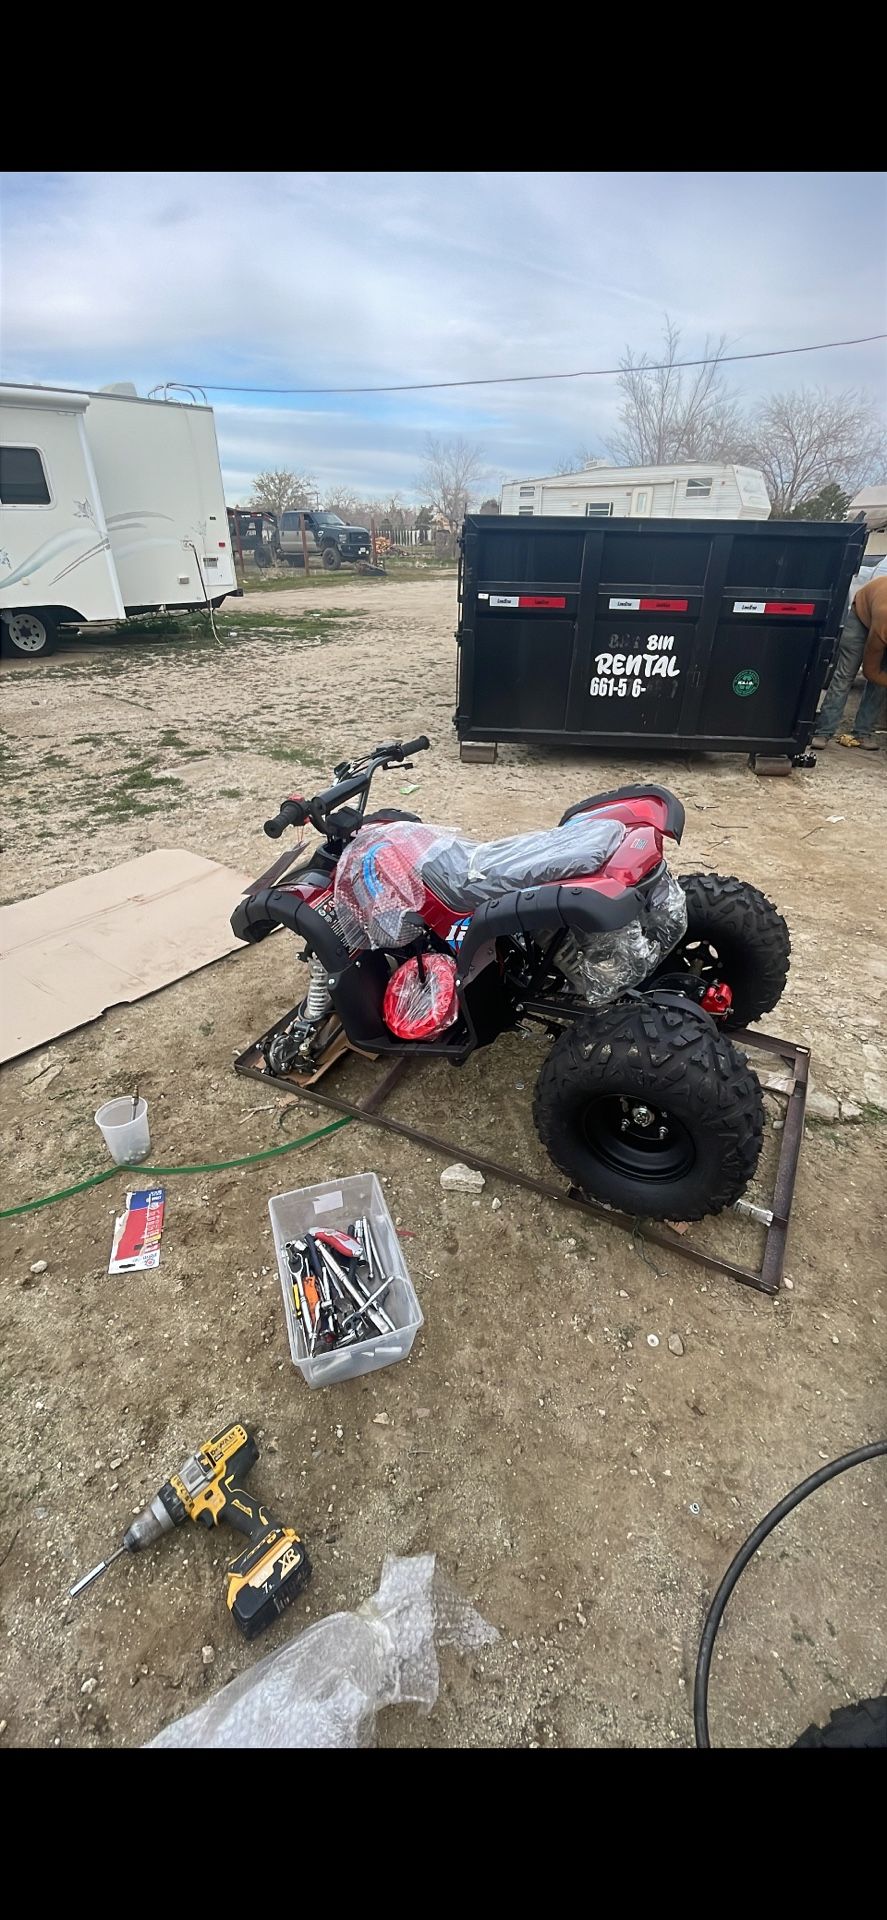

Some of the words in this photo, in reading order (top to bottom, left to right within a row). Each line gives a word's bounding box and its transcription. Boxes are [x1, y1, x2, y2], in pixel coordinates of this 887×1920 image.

[646, 634, 675, 651] BIN
[594, 652, 680, 678] RENTAL
[278, 1548, 300, 1570] XR
